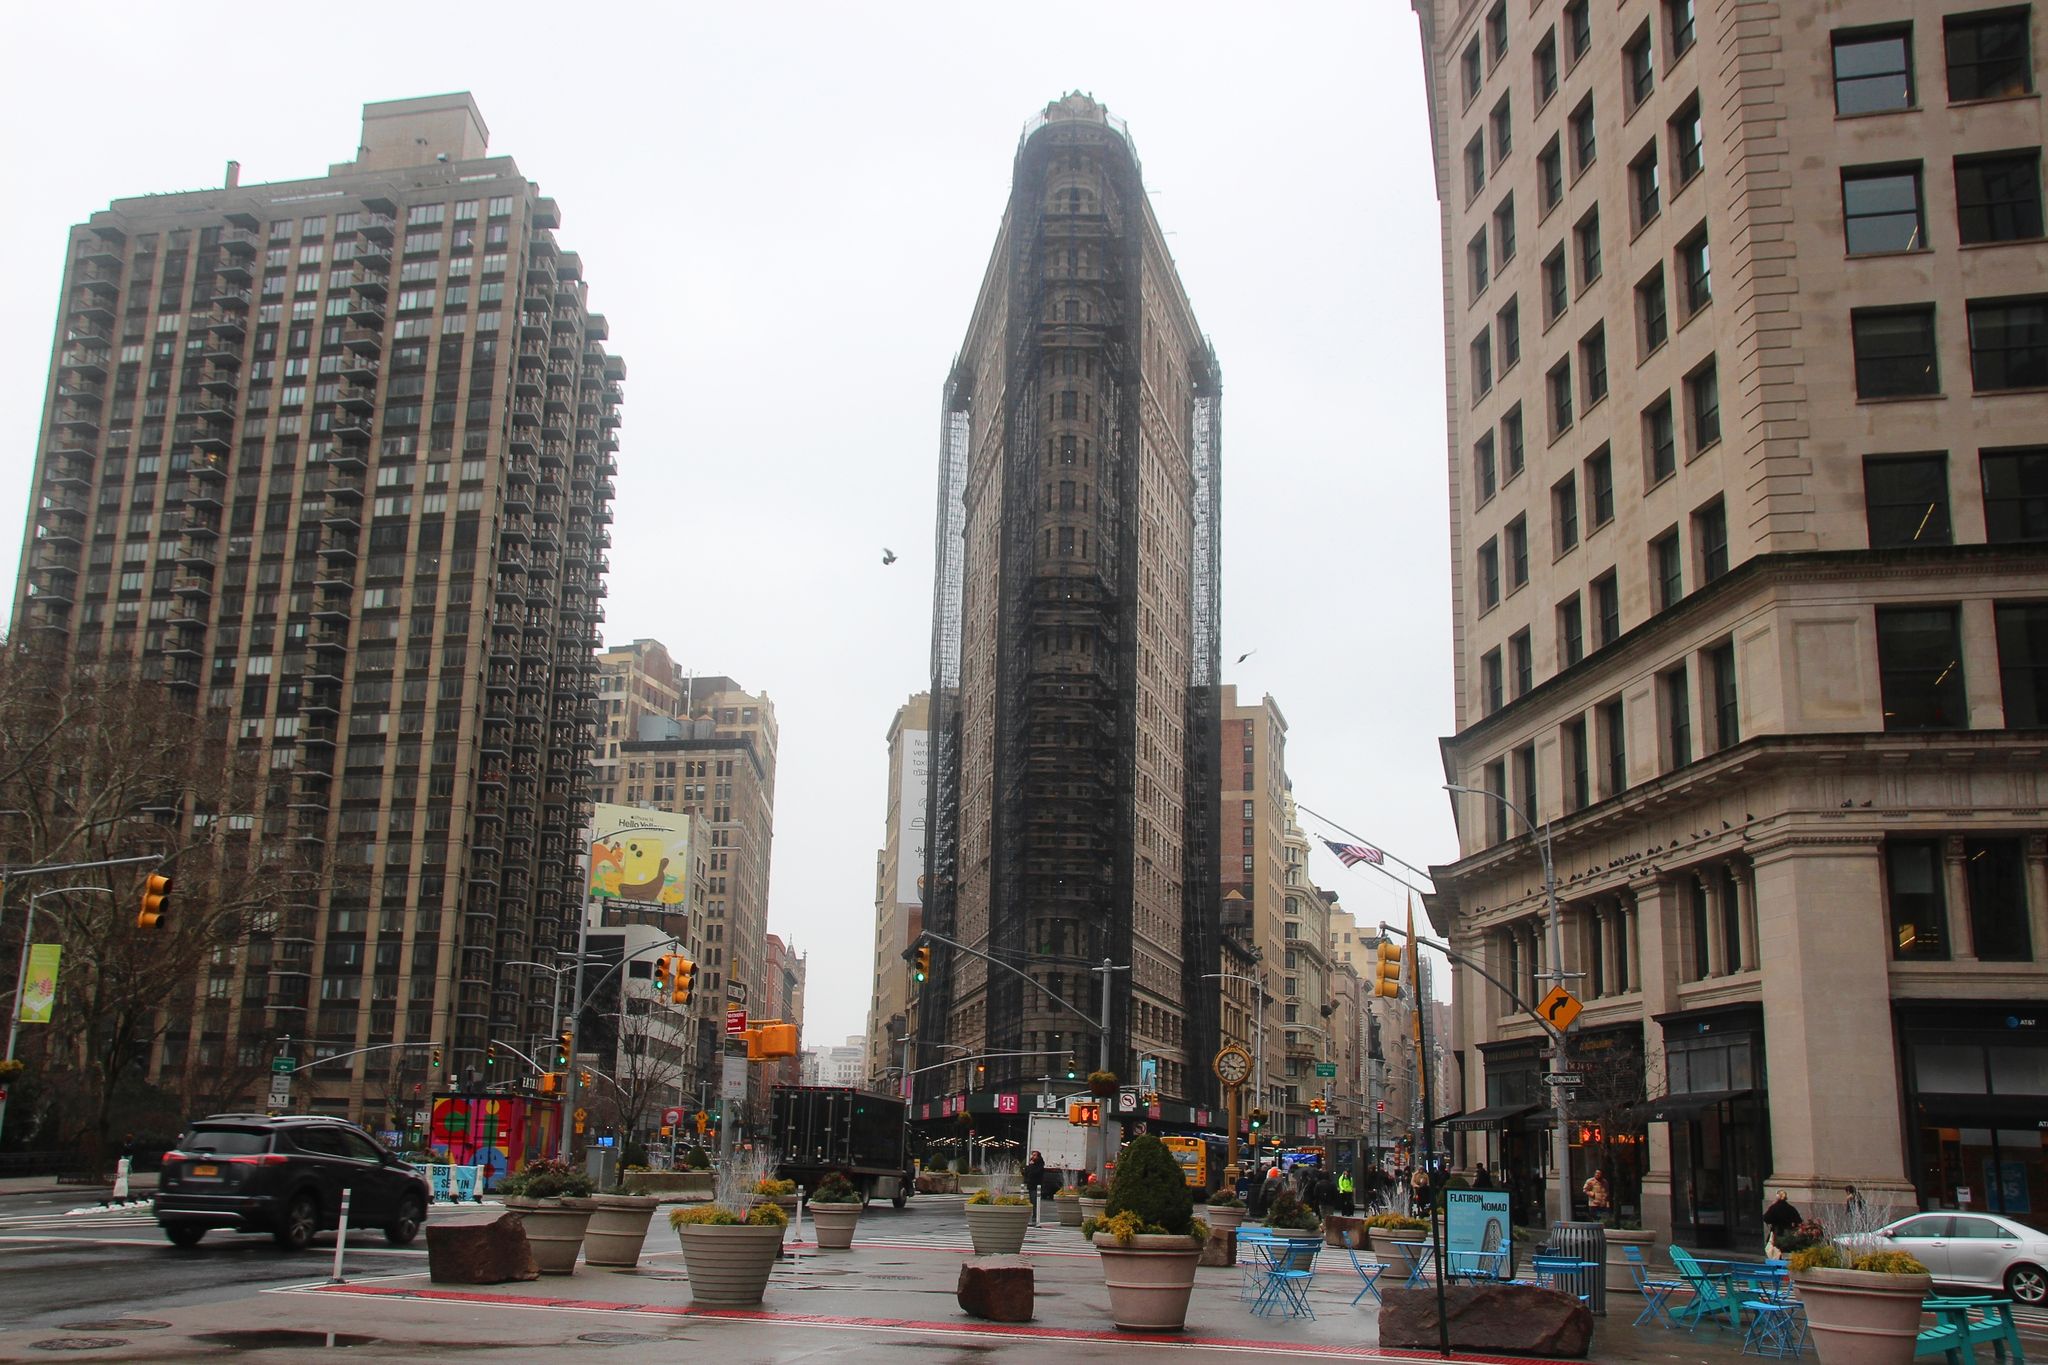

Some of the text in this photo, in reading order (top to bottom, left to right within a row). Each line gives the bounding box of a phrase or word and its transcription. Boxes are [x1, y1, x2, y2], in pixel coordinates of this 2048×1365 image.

[618, 818, 640, 828] Hello
[1092, 1109, 1098, 1121] 6
[1594, 1128, 1600, 1142] 5
[433, 1167, 451, 1177] BEST
[461, 1180, 470, 1189] IN
[1450, 1194, 1483, 1204] FLATIRON
[1482, 1202, 1507, 1212] NOMAD
